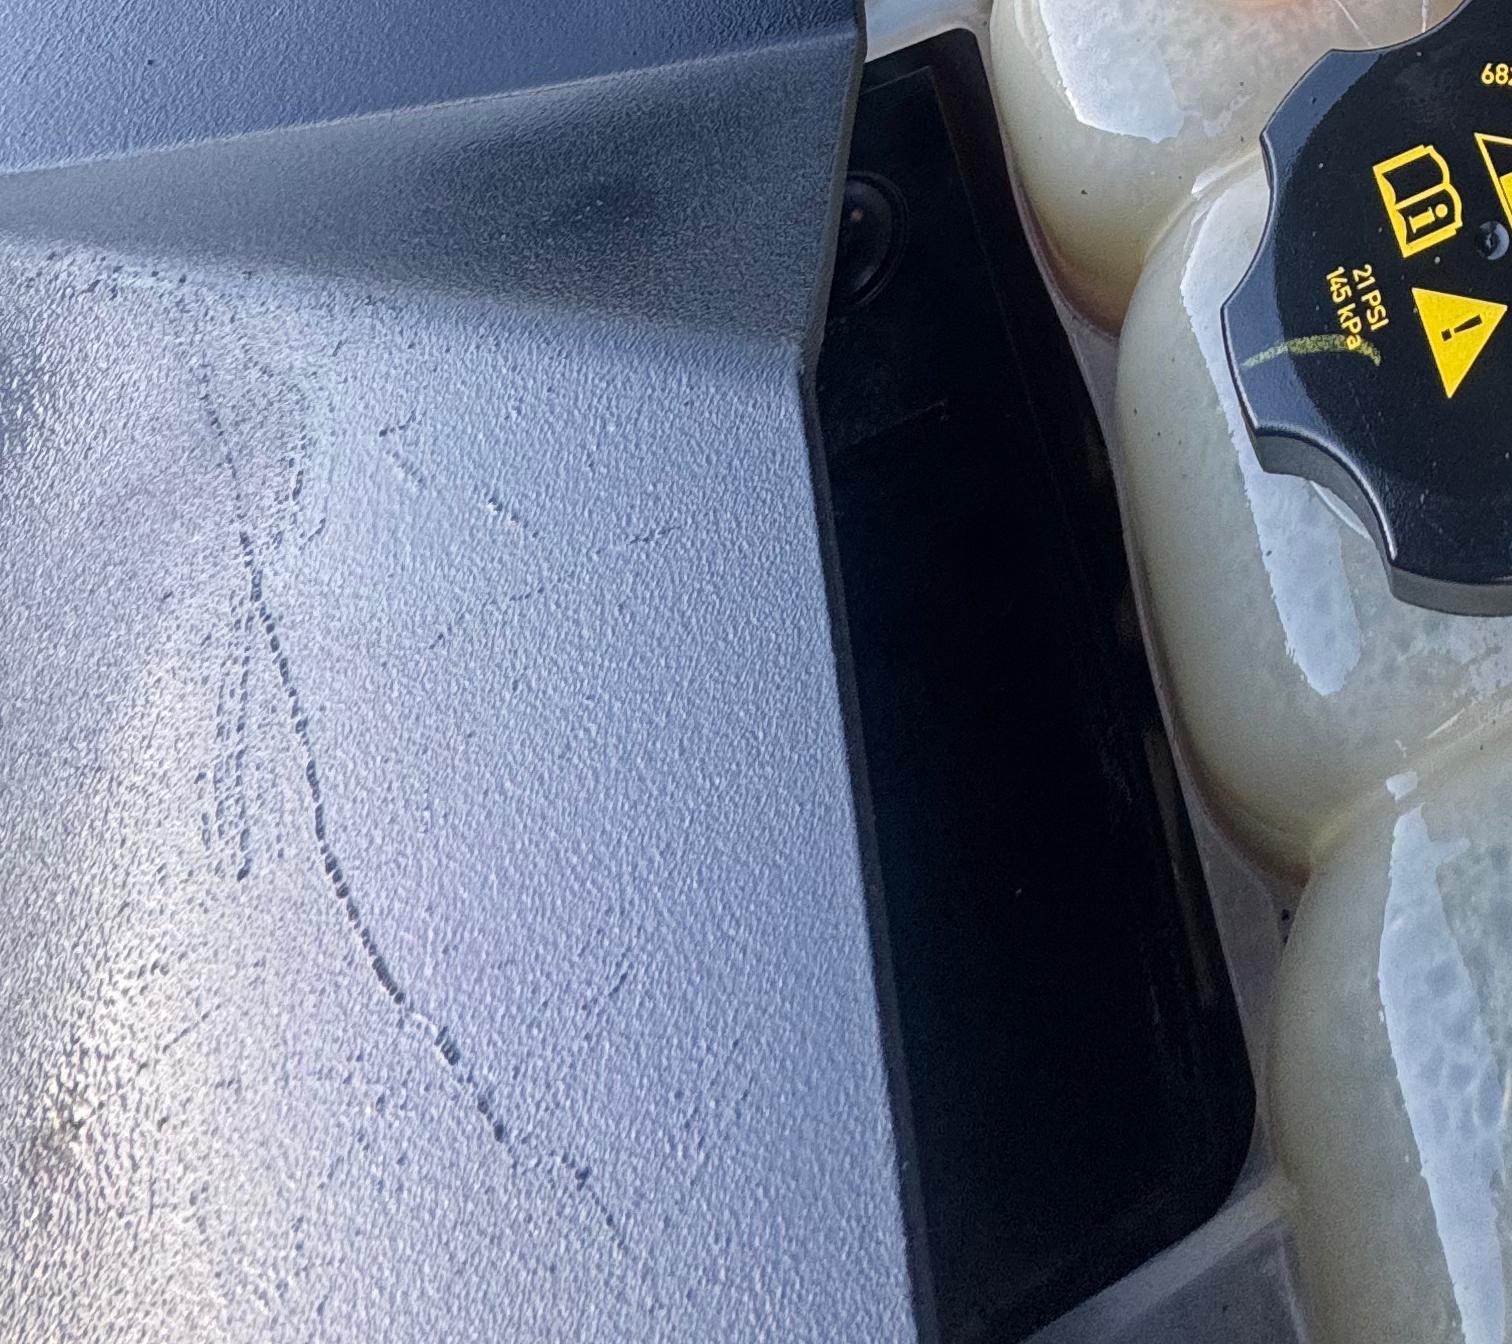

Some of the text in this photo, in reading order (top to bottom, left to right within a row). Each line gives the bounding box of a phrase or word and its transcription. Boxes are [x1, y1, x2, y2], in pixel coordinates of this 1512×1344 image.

[1326, 266, 1362, 350] 145 kPa
[1353, 264, 1389, 331] 21 PSI
